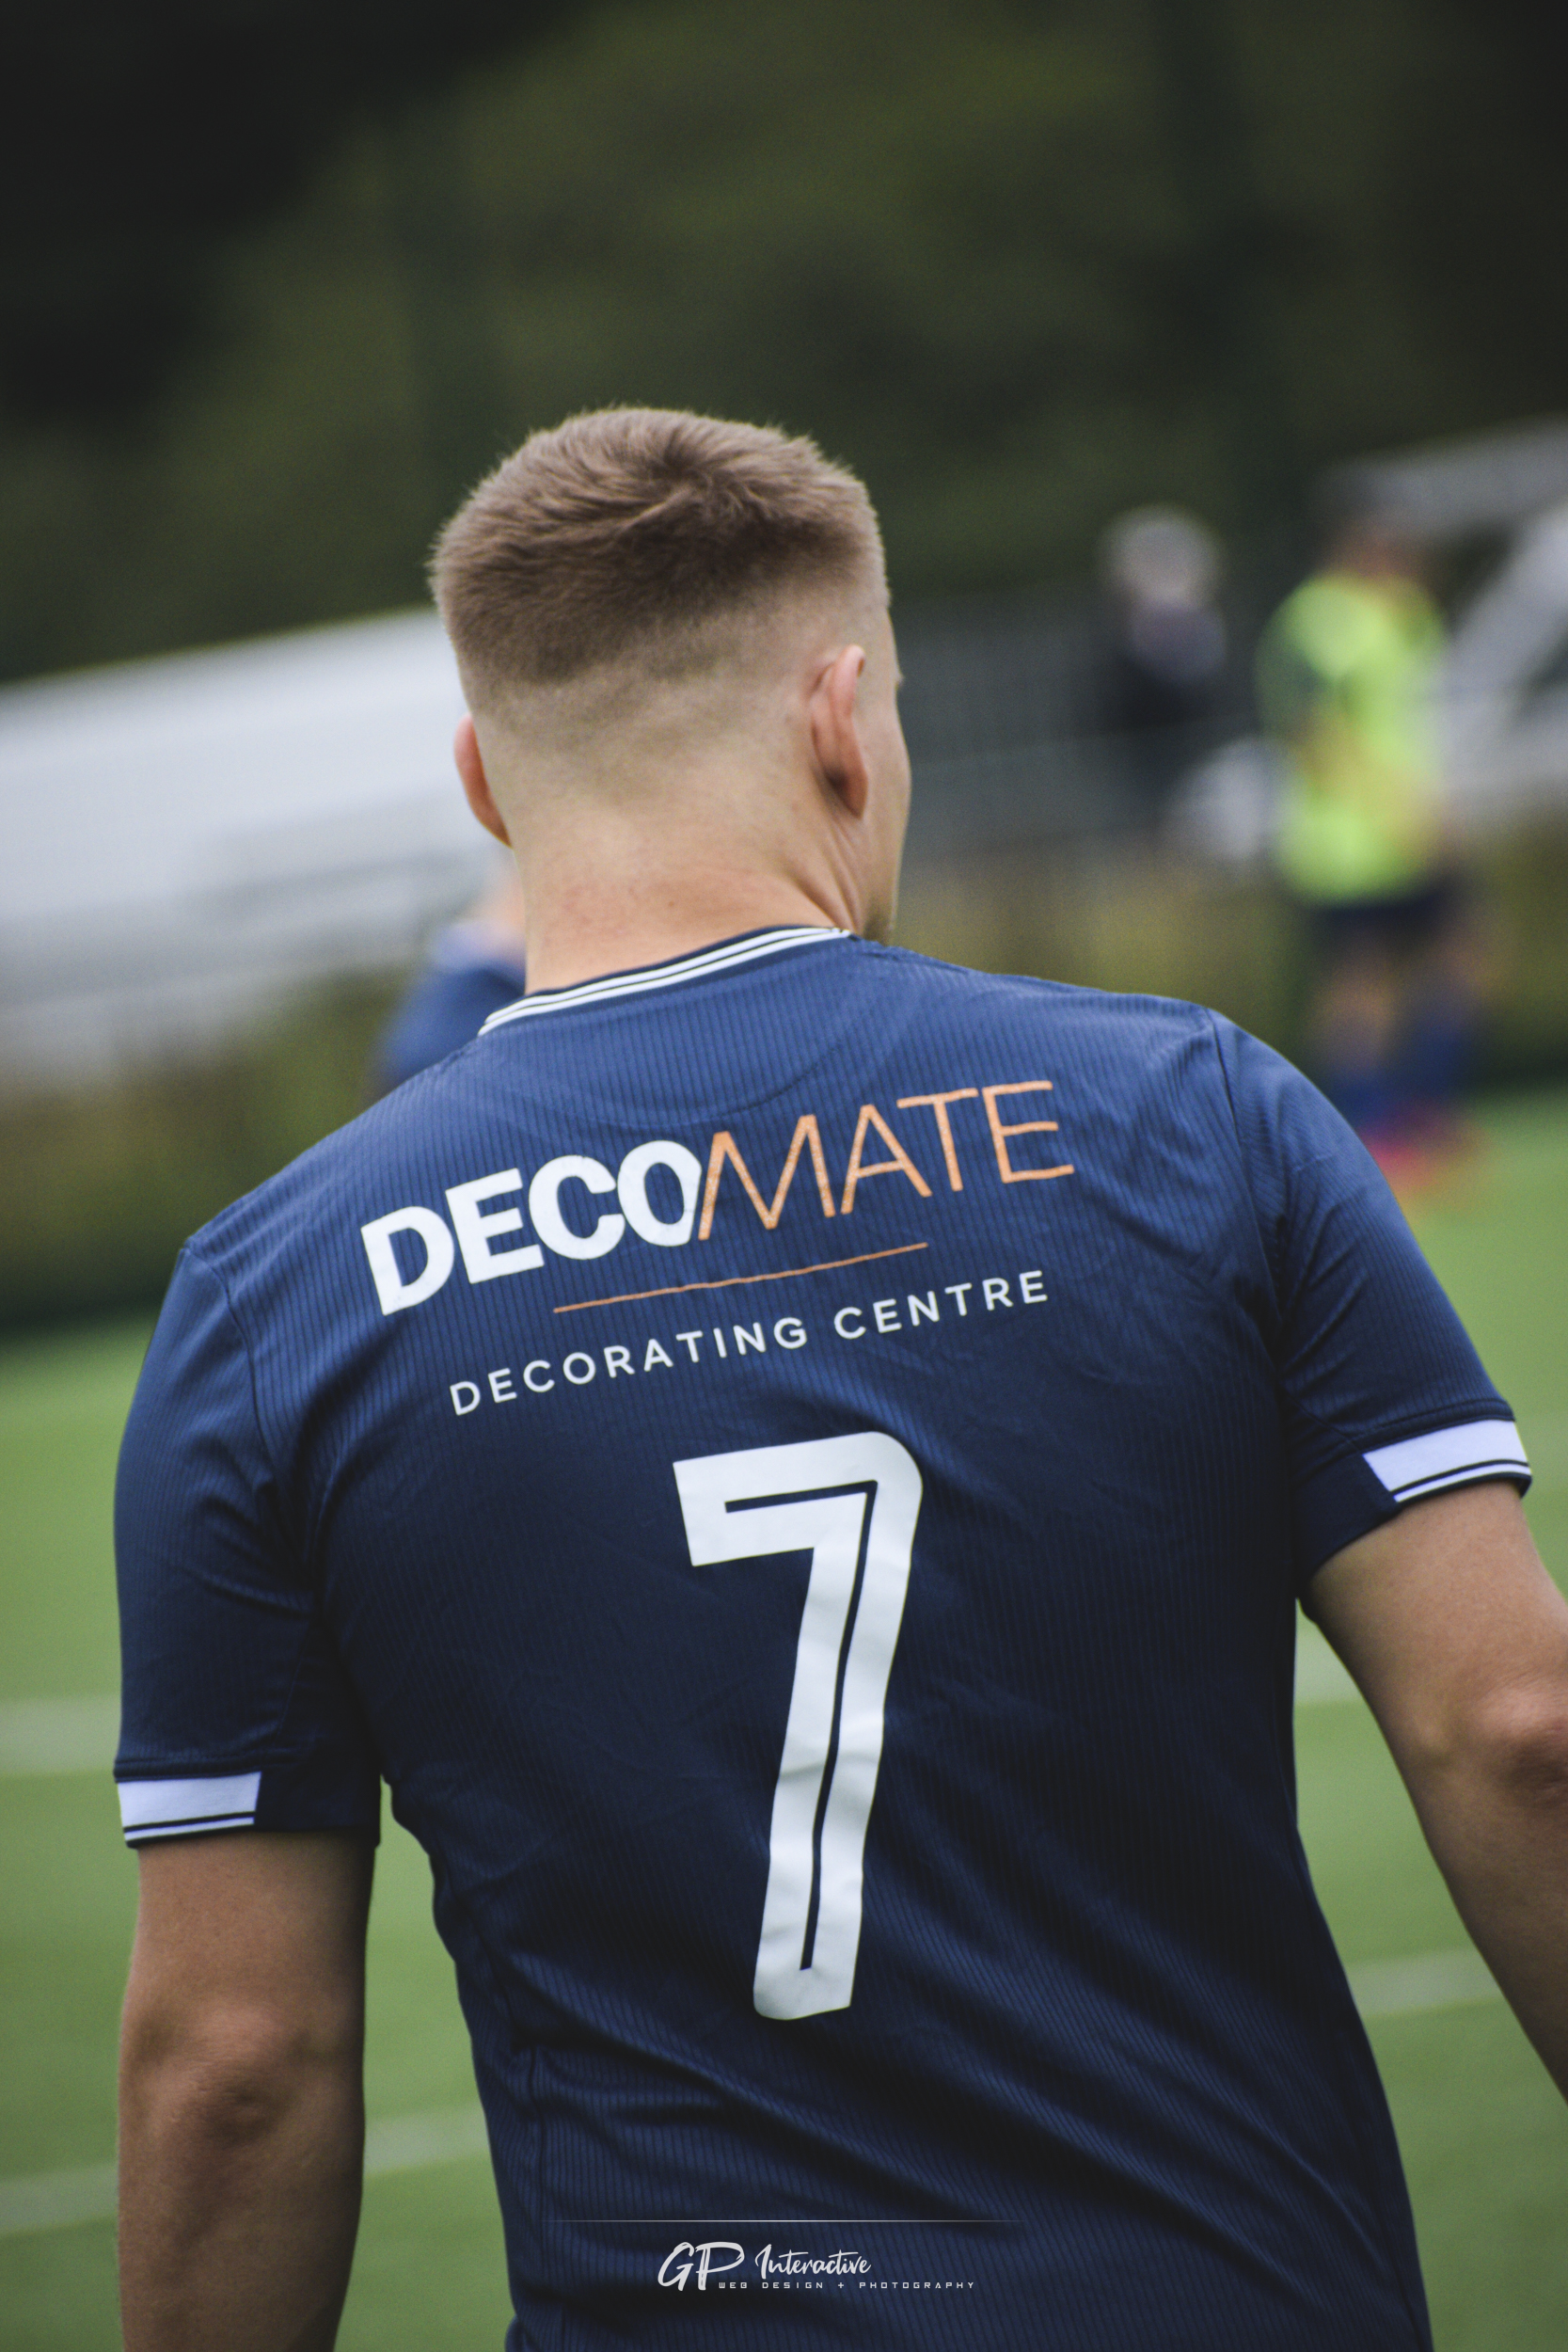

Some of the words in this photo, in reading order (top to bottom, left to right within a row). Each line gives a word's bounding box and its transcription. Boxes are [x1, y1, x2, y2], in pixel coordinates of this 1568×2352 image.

[360, 1079, 1075, 1316] DECOMATE
[450, 1316, 807, 1416] DECORATING
[833, 1270, 1049, 1340] CENTRE
[673, 1430, 923, 2020] 7
